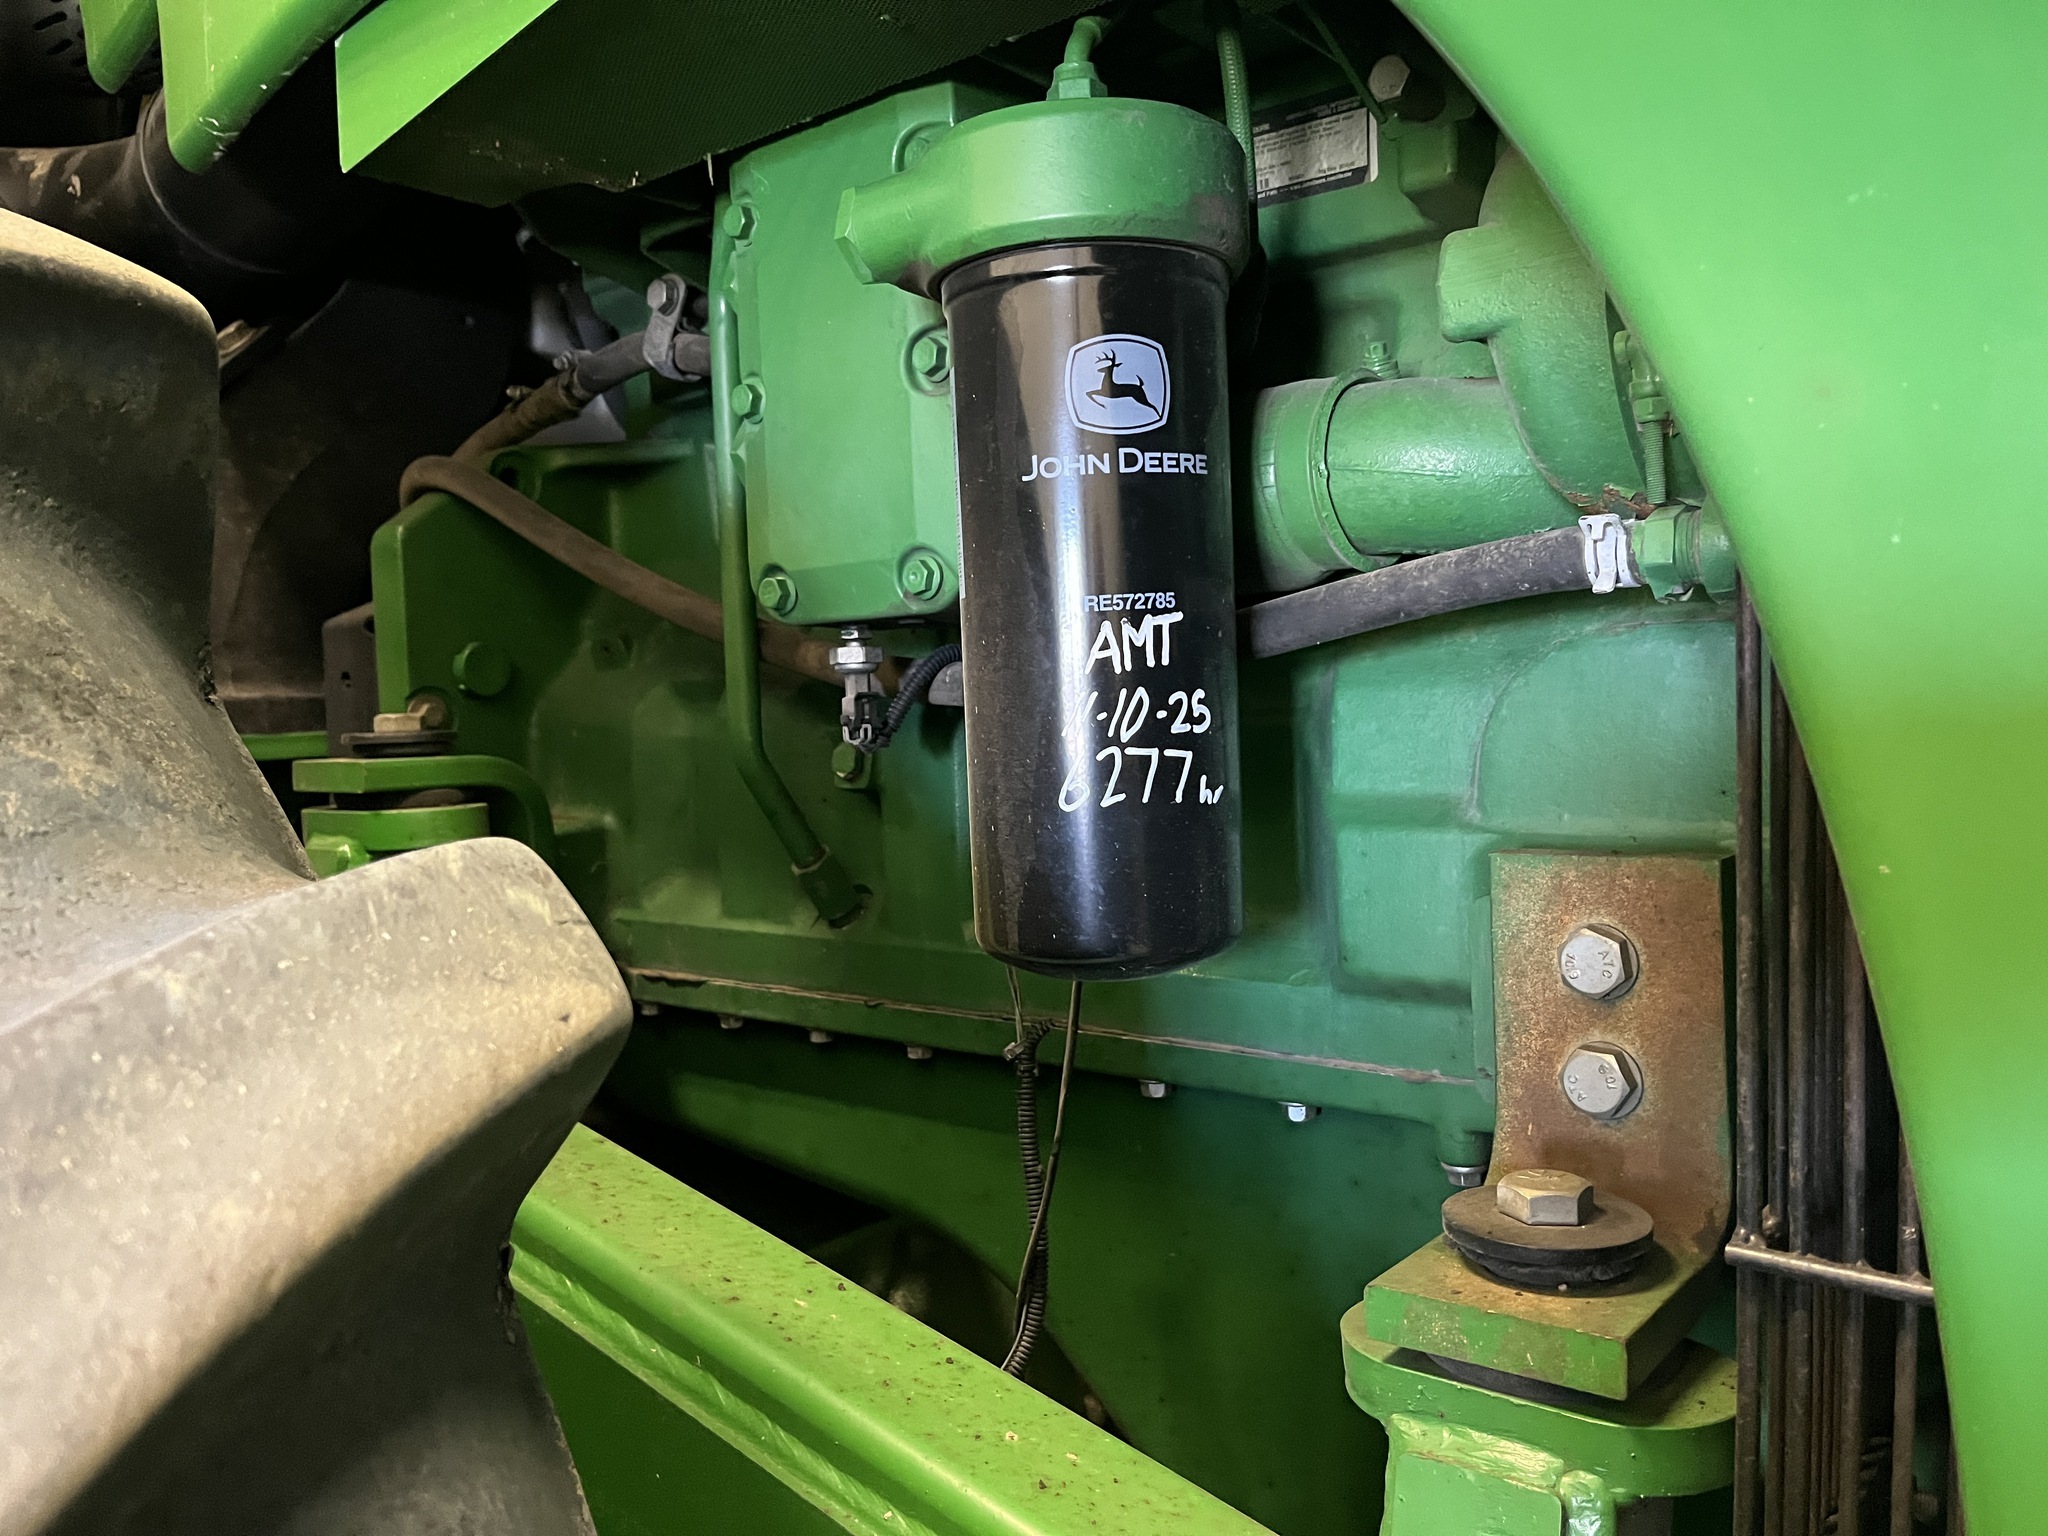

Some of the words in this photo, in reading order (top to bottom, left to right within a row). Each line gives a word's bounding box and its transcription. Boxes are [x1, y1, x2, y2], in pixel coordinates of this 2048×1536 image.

[1021, 452, 1110, 482] JOHN
[1118, 447, 1208, 475] DEERE
[1083, 592, 1176, 612] RE572785
[1084, 611, 1184, 675] AMT
